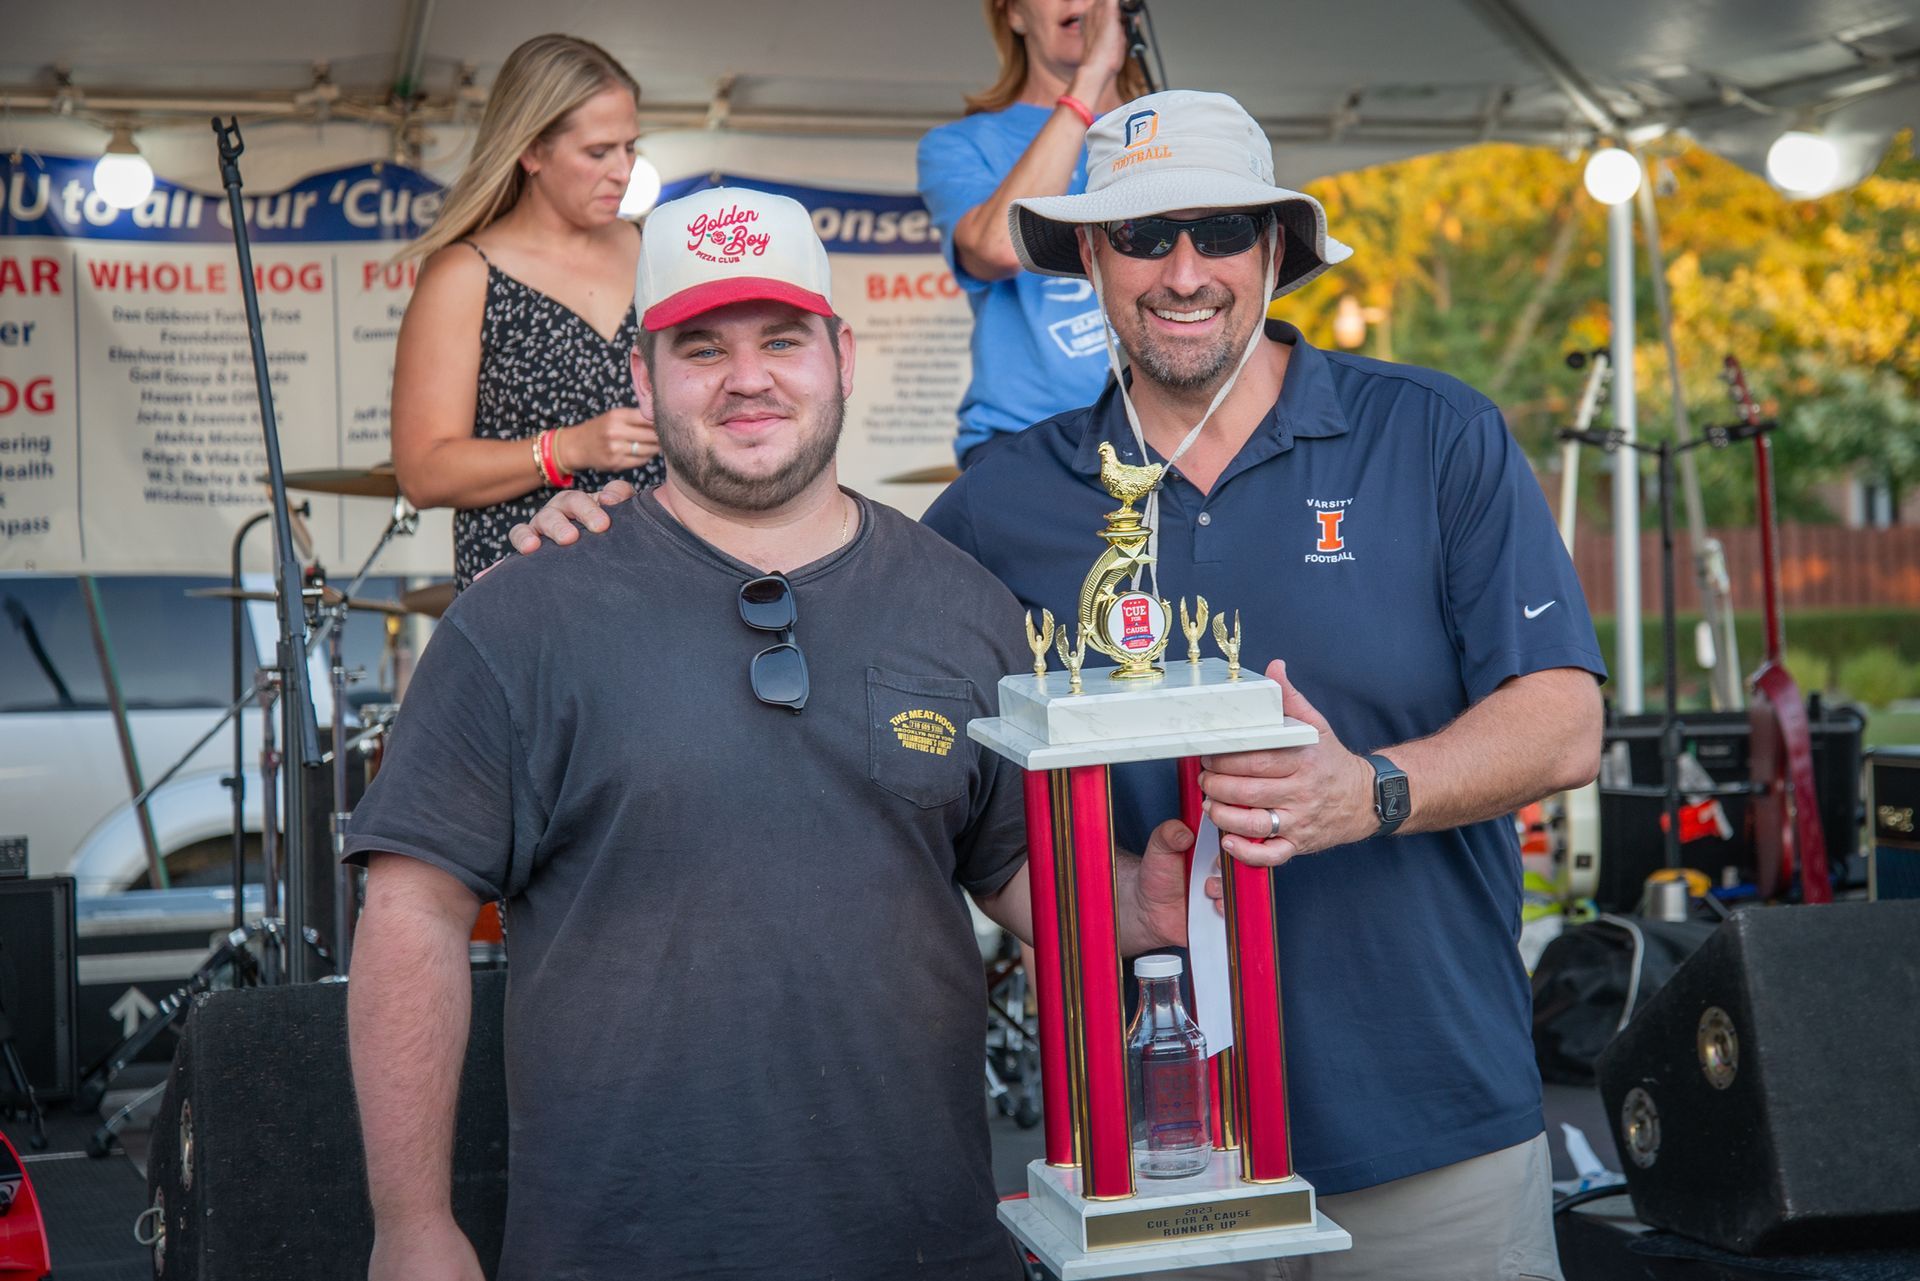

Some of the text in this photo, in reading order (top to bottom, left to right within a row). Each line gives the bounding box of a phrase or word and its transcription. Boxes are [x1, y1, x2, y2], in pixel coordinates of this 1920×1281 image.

[0, 172, 50, 222] U
[62, 179, 119, 227] to
[132, 189, 203, 229] all
[687, 204, 760, 251] Golden
[722, 225, 770, 257] Boy
[695, 250, 741, 264] PIZZA CLUB
[0, 258, 61, 296] AR
[88, 260, 226, 293] WHOLE
[866, 271, 961, 302] BACO
[0, 321, 35, 347] er
[0, 377, 56, 415] OG
[0, 432, 51, 457] ering
[1306, 498, 1354, 509] VARSITY
[1304, 552, 1356, 563] FOOTBALL
[1126, 626, 1148, 634] CAUSE
[889, 712, 908, 725] THE
[909, 710, 934, 719] MEAT
[935, 713, 956, 736] HOOK
[1146, 1209, 1252, 1229] CUE FOR A CAUSE
[1184, 1206, 1213, 1216] 2023
[1163, 1220, 1237, 1236] RUNNER UP
